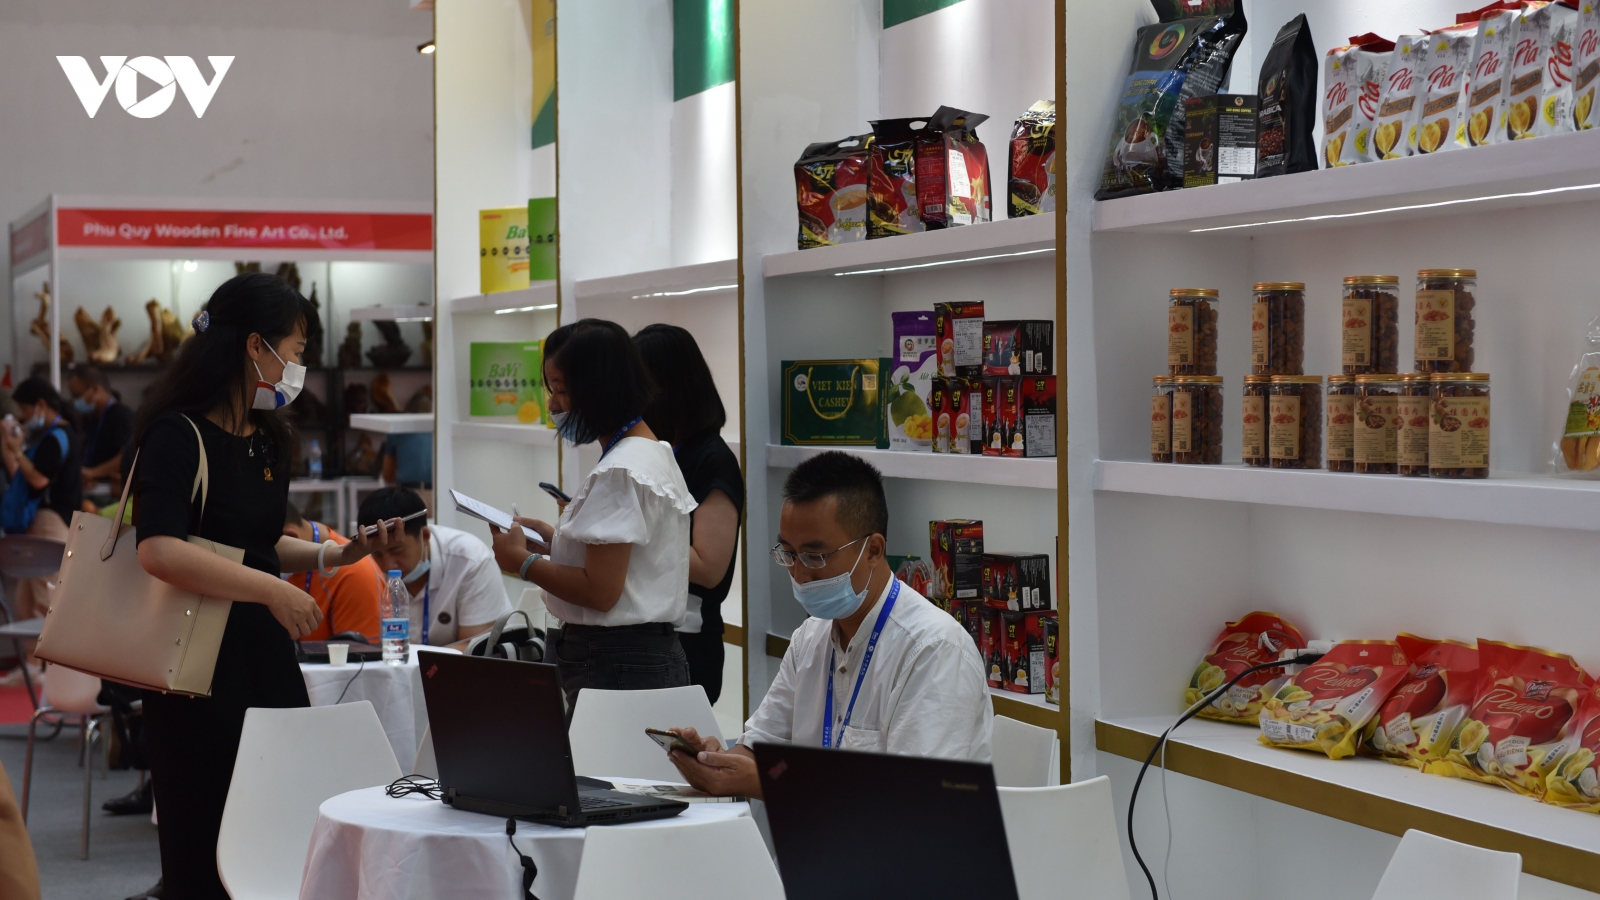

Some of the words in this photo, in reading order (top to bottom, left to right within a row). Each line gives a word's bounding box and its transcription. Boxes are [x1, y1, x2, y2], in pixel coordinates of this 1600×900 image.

[83, 223, 116, 236] Phu
[119, 223, 151, 240] Quy
[155, 224, 221, 237] Wooden
[224, 225, 257, 238] Fine
[261, 226, 285, 239] Art
[288, 226, 317, 241] Co.,
[320, 226, 348, 240] Ltd.
[812, 380, 832, 391] VIET
